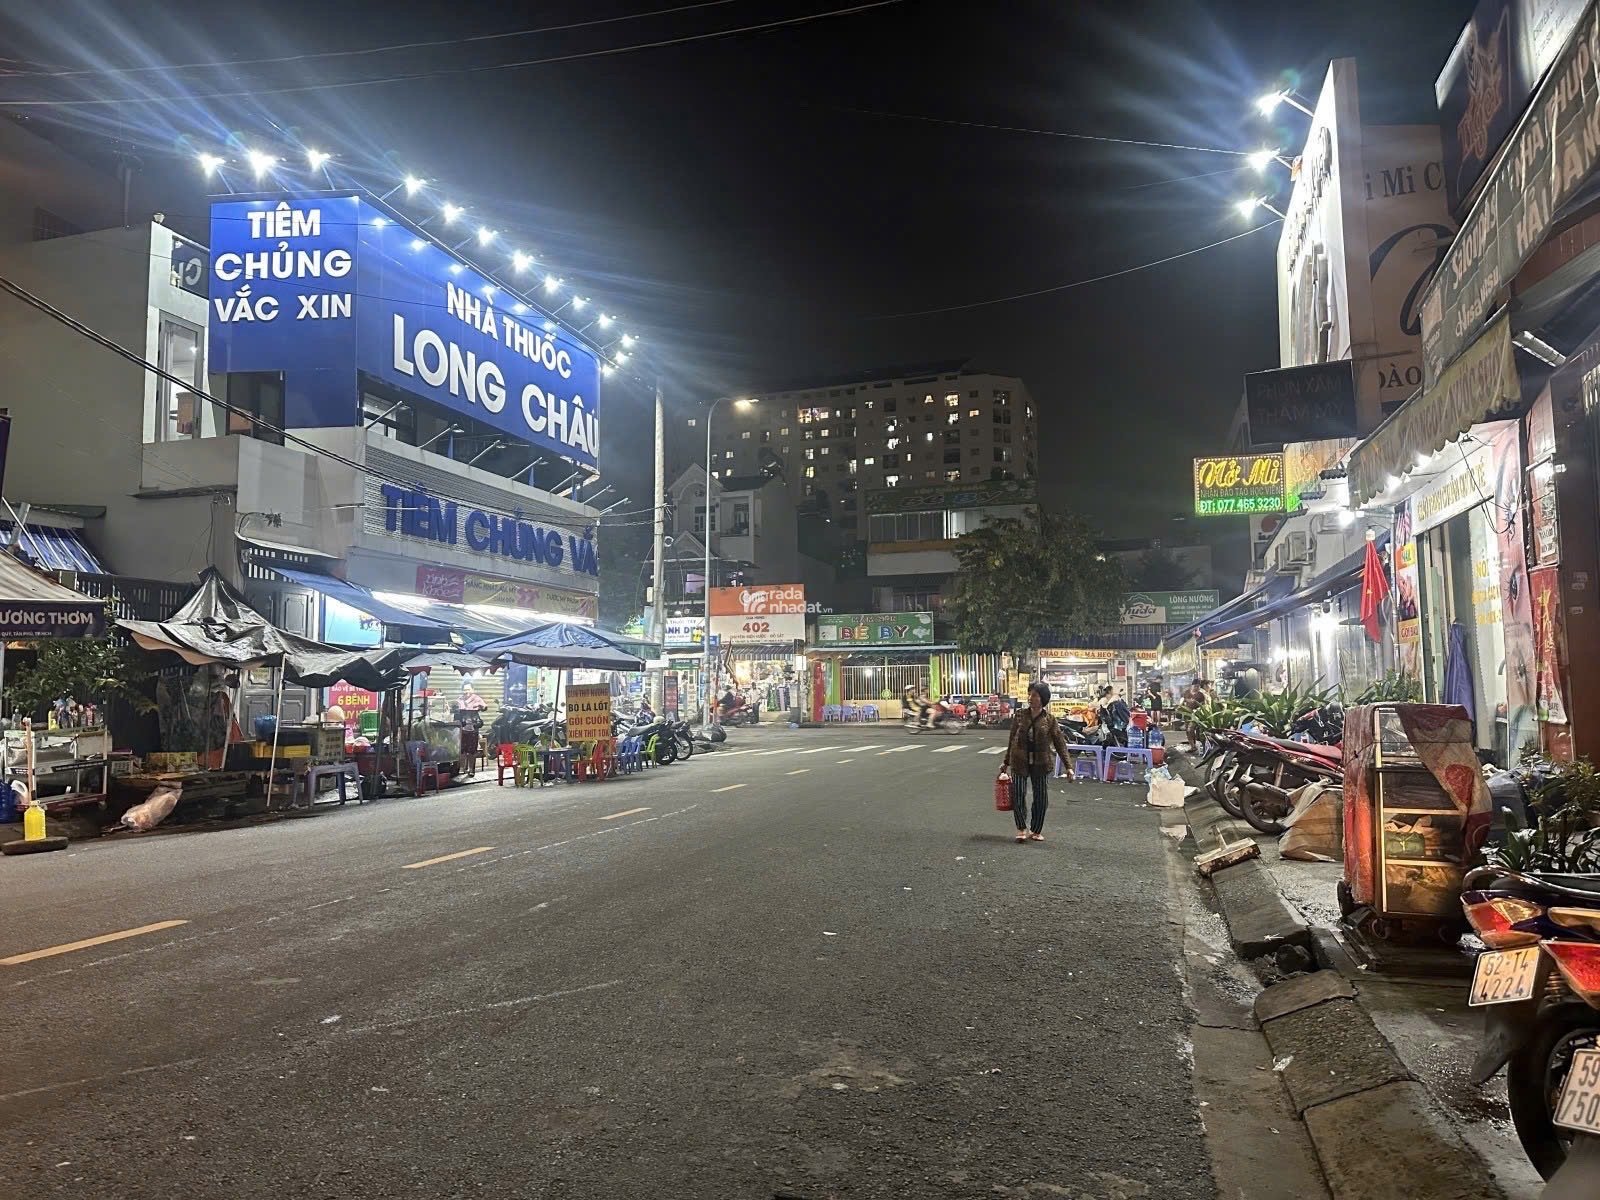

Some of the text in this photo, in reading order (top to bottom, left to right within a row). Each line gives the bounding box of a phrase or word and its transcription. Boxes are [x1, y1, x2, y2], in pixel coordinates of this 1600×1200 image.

[247, 201, 321, 239] TIÊM
[214, 241, 352, 281] CHỦNG
[214, 284, 351, 322] VẮC XIN
[447, 282, 572, 379] NHÀ THUỐC
[394, 313, 599, 458] LONG CHÂU
[1200, 497, 1281, 512] ĐT: 077 465 3230
[381, 480, 459, 545] TIÊM
[465, 504, 564, 567] CHỦNG
[47, 610, 93, 625] THƠM
[742, 621, 770, 633] 402
[839, 622, 909, 640] BÉ BY
[337, 692, 370, 708] 6 BỆNH
[1480, 975, 1524, 1000] 4224
